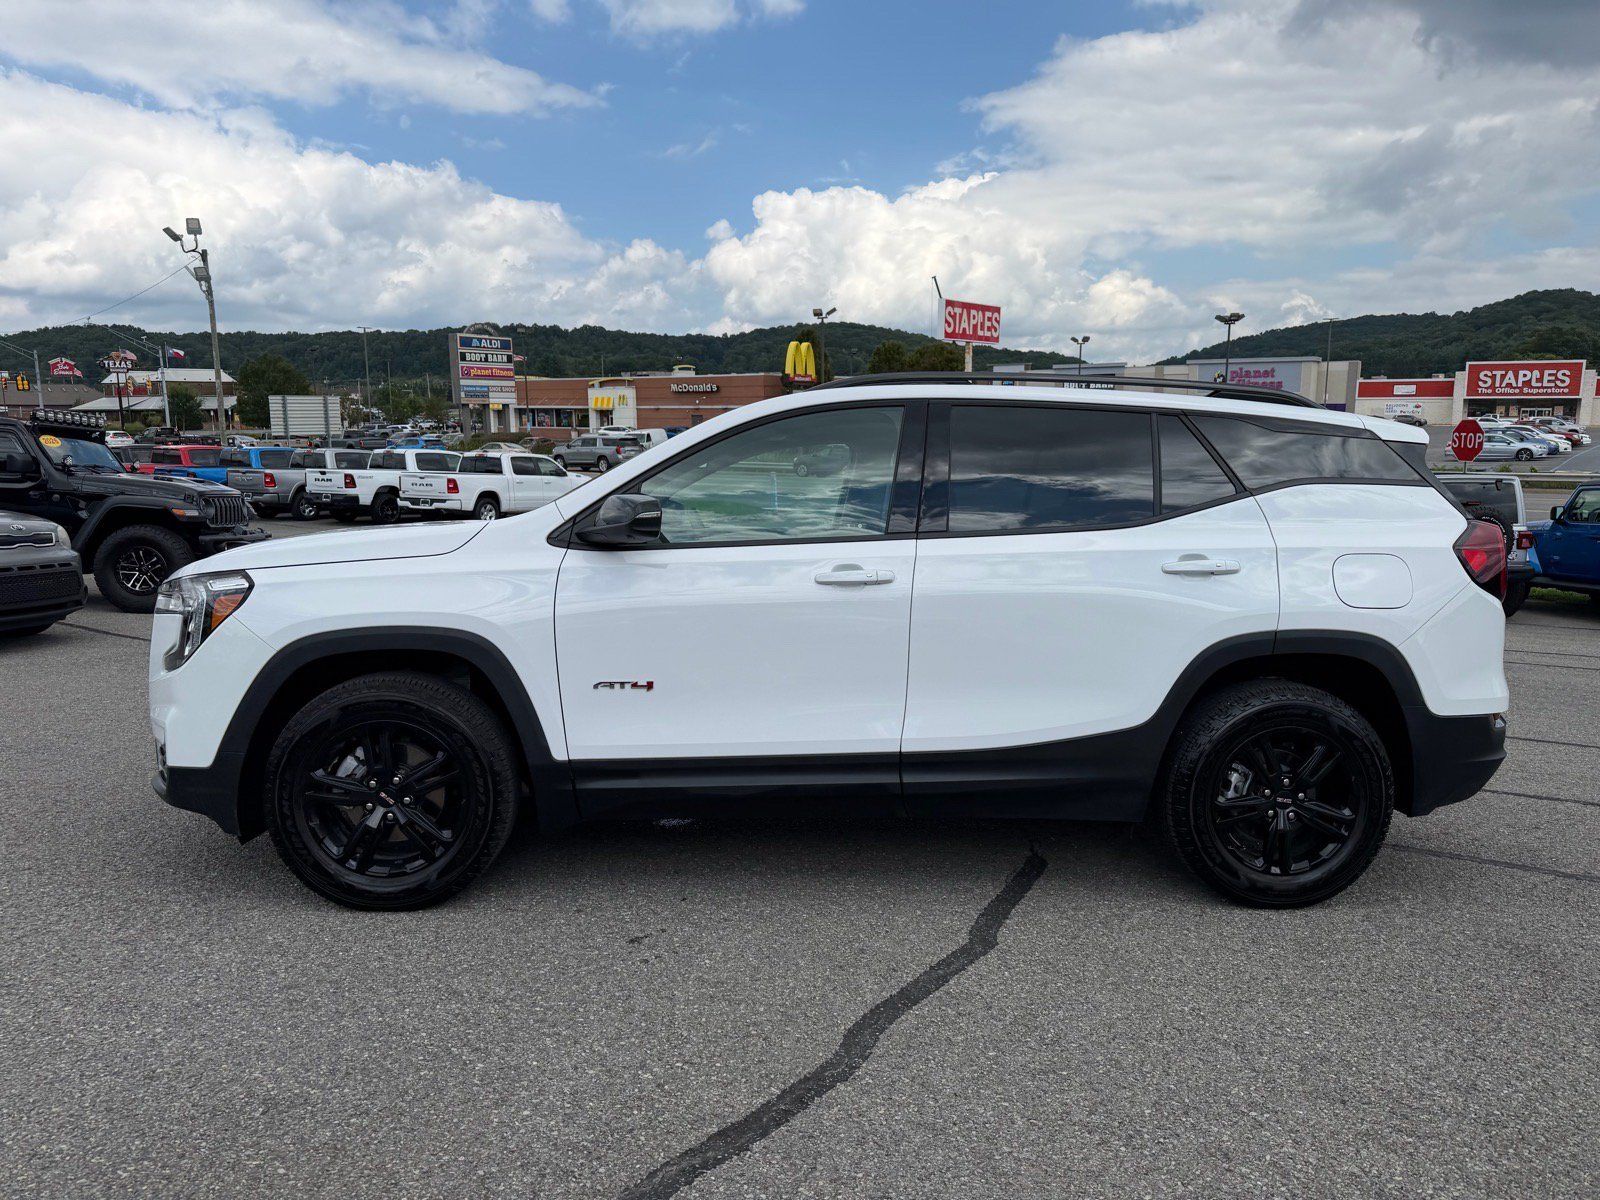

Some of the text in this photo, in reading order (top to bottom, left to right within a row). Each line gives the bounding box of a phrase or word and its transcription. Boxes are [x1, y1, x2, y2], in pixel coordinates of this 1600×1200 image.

[945, 306, 1000, 338] STAPLES
[481, 339, 501, 348] ALDI
[465, 353, 508, 362] BOOT BARN
[103, 360, 132, 368] TEXAS
[470, 367, 514, 377] planet fitness
[1229, 367, 1276, 382] planet
[1478, 370, 1571, 388] STAPLES
[670, 383, 718, 393] McDonald's
[1523, 387, 1569, 395] Superstore
[1452, 432, 1483, 449] STOP
[593, 681, 654, 691] AT4
